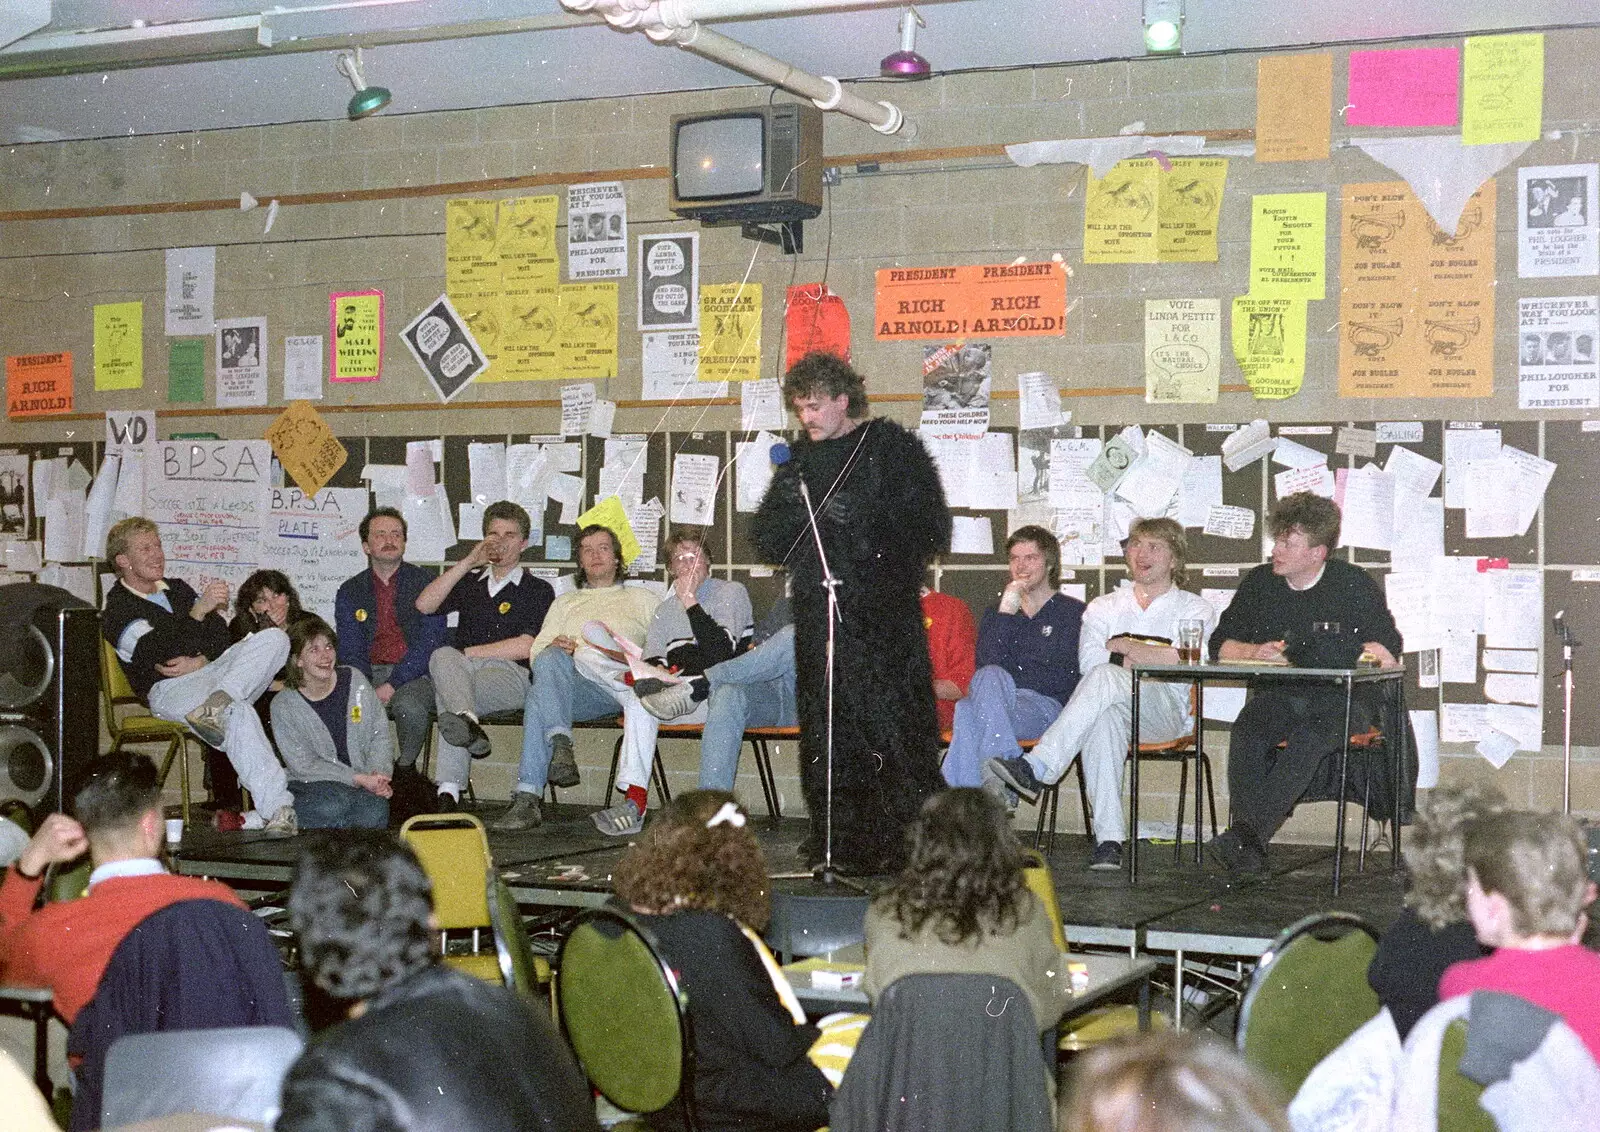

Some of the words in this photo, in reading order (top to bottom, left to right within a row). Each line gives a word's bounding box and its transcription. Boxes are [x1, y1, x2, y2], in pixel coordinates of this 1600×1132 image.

[569, 186, 619, 195] WHICHEVER
[1534, 257, 1580, 265] PRESIDENT
[576, 268, 622, 277] PRESIDENT
[890, 268, 956, 281] PRESIDENT
[983, 264, 1052, 278] PRESIDENT
[897, 299, 946, 315] RICH
[991, 295, 1041, 311] RICH
[1169, 301, 1195, 309] VOTE
[1521, 301, 1589, 310] WHICHEVER
[704, 305, 755, 313] GOODMAN
[1521, 310, 1543, 318] WAY
[1549, 309, 1567, 317] YOU
[1570, 308, 1597, 316] LOOK
[1150, 312, 1178, 320] LINDA
[972, 316, 1064, 333] ARNOLD!
[1521, 318, 1534, 326] AT
[878, 319, 967, 336] ARNOLD!
[1172, 324, 1190, 332] FOR
[17, 354, 62, 366] PRESIDENT
[700, 356, 757, 364] PRESIDENT
[1521, 374, 1546, 382] PHIL
[1549, 372, 1597, 380] LOUGHER
[23, 381, 56, 394] RICH
[1548, 384, 1569, 392] FOR
[9, 396, 72, 412] ARNOLD!
[1528, 398, 1591, 407] PRESIDENT
[164, 445, 260, 477] BPSA
[279, 520, 319, 535] PLATE
